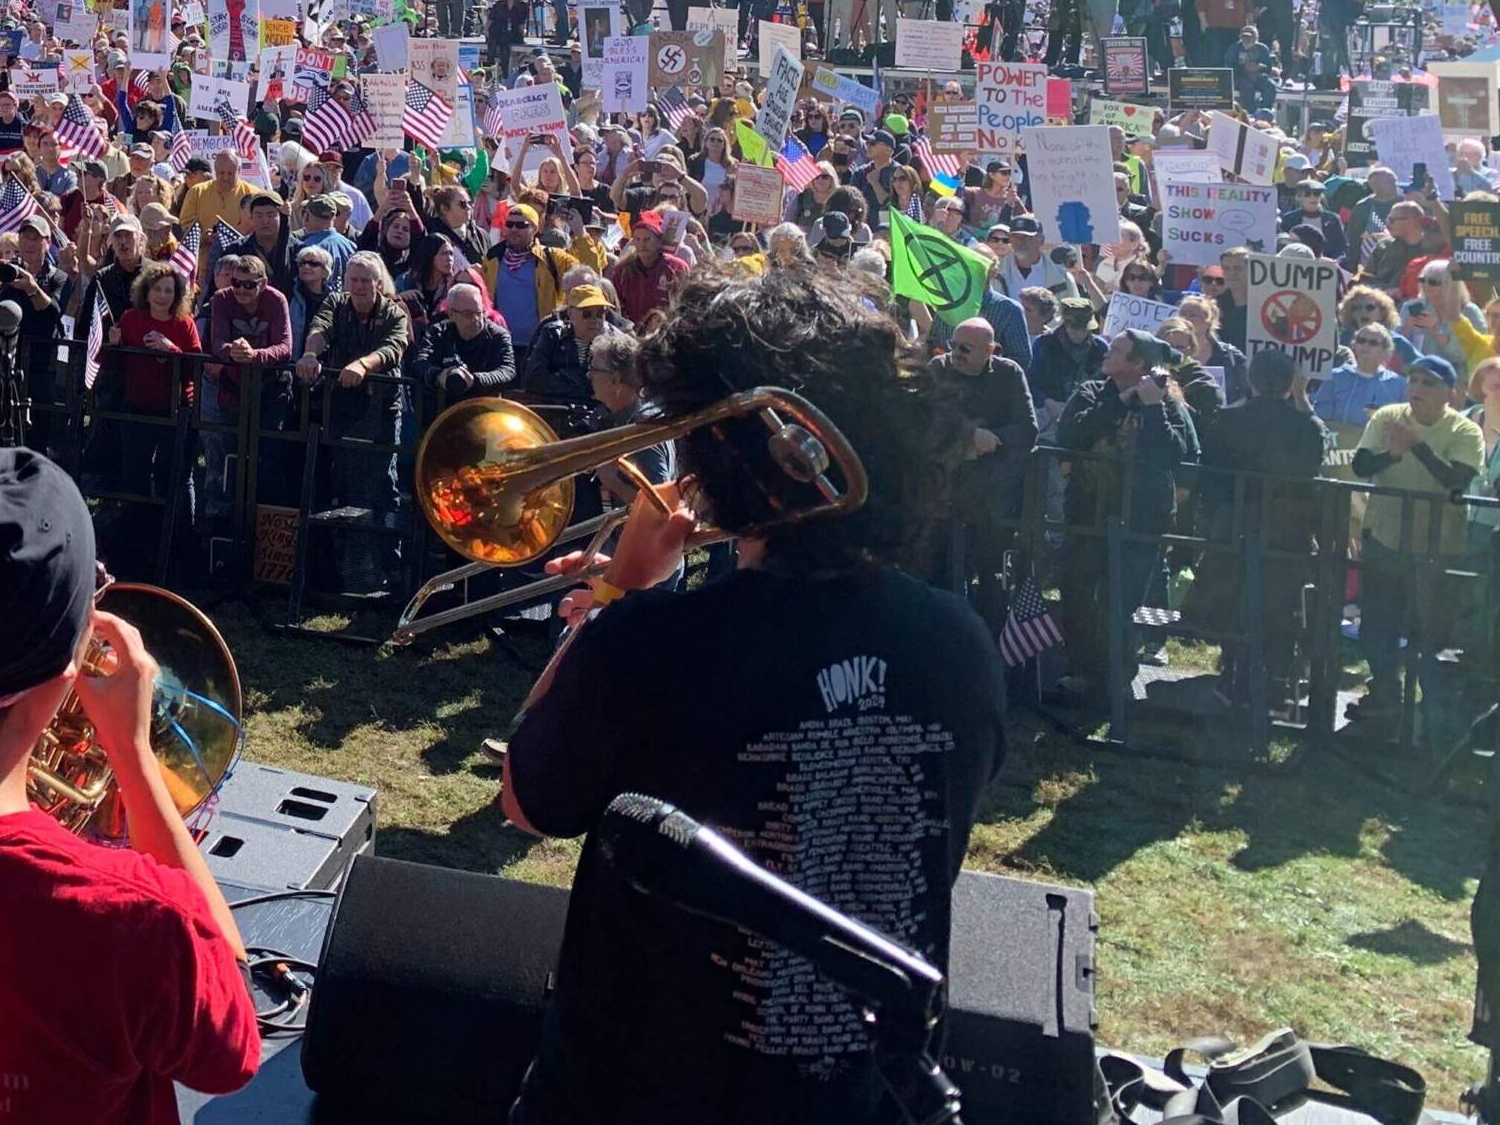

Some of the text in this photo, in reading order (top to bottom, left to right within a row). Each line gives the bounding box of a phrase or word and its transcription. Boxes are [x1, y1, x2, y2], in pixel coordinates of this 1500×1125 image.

[217, 87, 231, 96] ARE
[1010, 89, 1044, 108] The
[499, 93, 548, 108] DEMOCRACY
[978, 104, 1045, 134] People
[1166, 184, 1272, 203] THIS REALITY
[1168, 205, 1217, 220] SHOW
[1464, 212, 1492, 224] FREE
[1168, 226, 1225, 245] SUCKS
[1464, 238, 1493, 251] FREE
[1454, 250, 1500, 264] COUNTR
[1251, 260, 1335, 291] DUMP
[816, 655, 888, 713] HONK!
